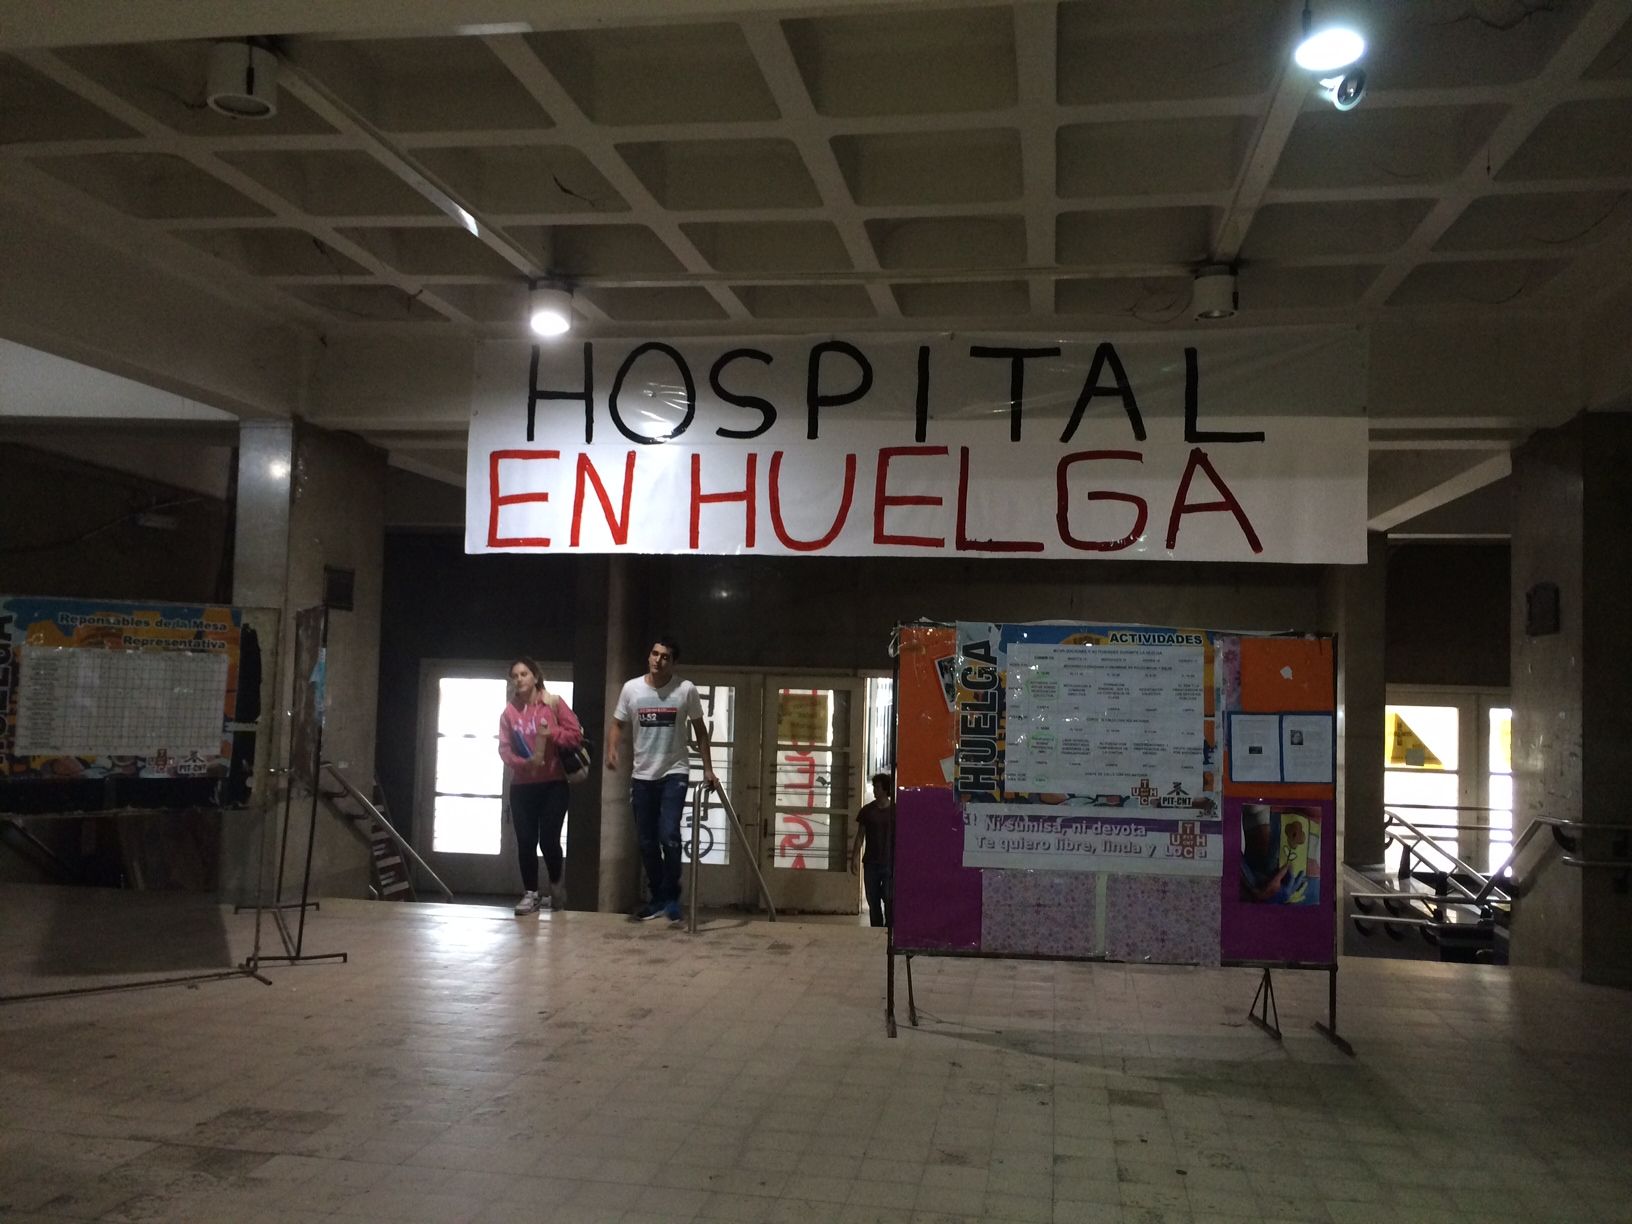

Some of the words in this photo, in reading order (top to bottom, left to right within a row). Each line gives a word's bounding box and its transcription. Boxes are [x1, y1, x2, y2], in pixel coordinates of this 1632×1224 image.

[526, 341, 1266, 443] HOSPITAL
[486, 449, 636, 549] EN
[690, 444, 1264, 554] HUELGA
[60, 612, 150, 628] Reponsables
[192, 620, 228, 632] Mesa
[124, 635, 226, 650] Representativa
[1109, 632, 1203, 645] ACTIVIDADES
[959, 639, 999, 792] HUELGA
[179, 764, 207, 773] PIT-CNT
[1162, 796, 1192, 806] PIT-CNT
[1072, 820, 1091, 835] ni
[1093, 820, 1147, 837] devota
[976, 837, 995, 850] Te
[1001, 838, 1051, 855] quiero
[1055, 838, 1097, 853] libre,
[1102, 839, 1142, 855] linda
[1147, 843, 1157, 857] y
